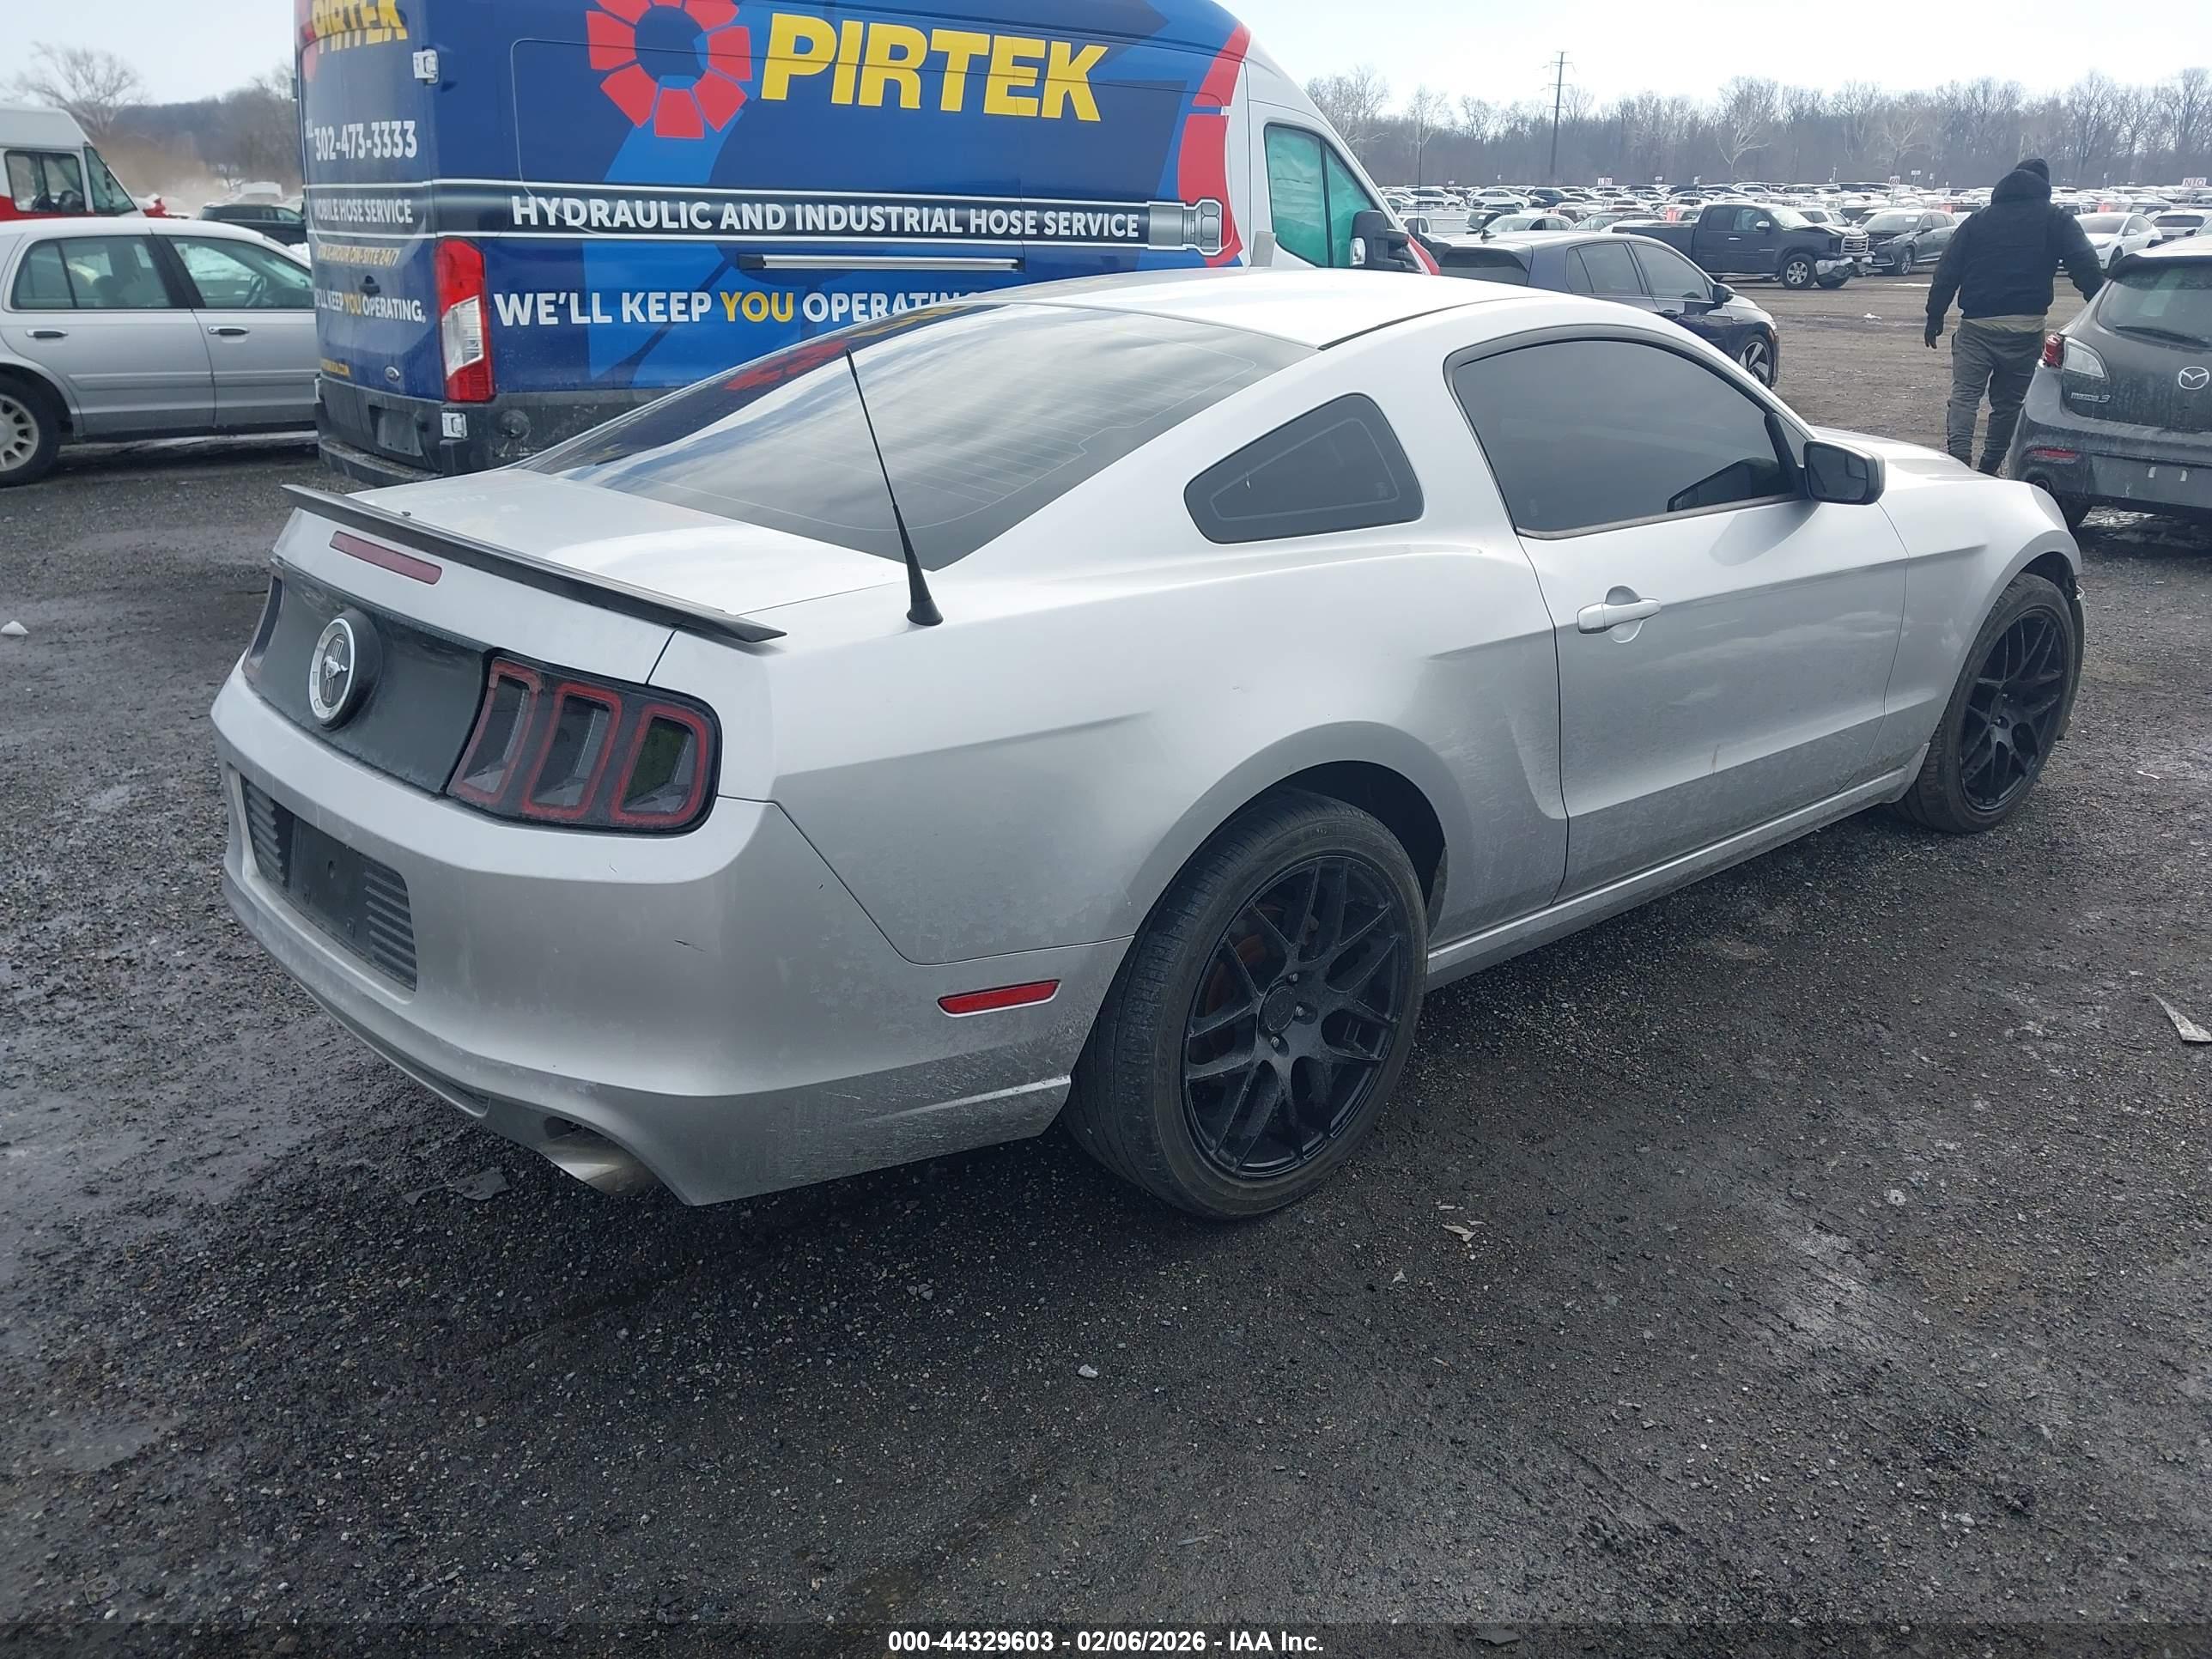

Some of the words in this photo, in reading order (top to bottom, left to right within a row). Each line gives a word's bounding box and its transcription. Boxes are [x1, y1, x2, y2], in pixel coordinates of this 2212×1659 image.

[760, 12, 1109, 122] PIRTEK
[314, 120, 417, 161] 302-473-3333
[340, 198, 364, 222] HOSE
[364, 198, 413, 224] SERVICE
[511, 195, 712, 230] HYDRAULIC
[720, 203, 787, 230] AND
[795, 204, 963, 234] INDUSTRIAL
[969, 209, 1037, 234] HOSE
[1042, 210, 1139, 238] SERVICE
[326, 290, 343, 312] KEEP
[343, 293, 362, 316] YOU
[362, 295, 426, 323] OPERATING.
[622, 292, 712, 323] KEEP
[720, 292, 793, 322] YOU
[802, 292, 975, 322] OPERAT
